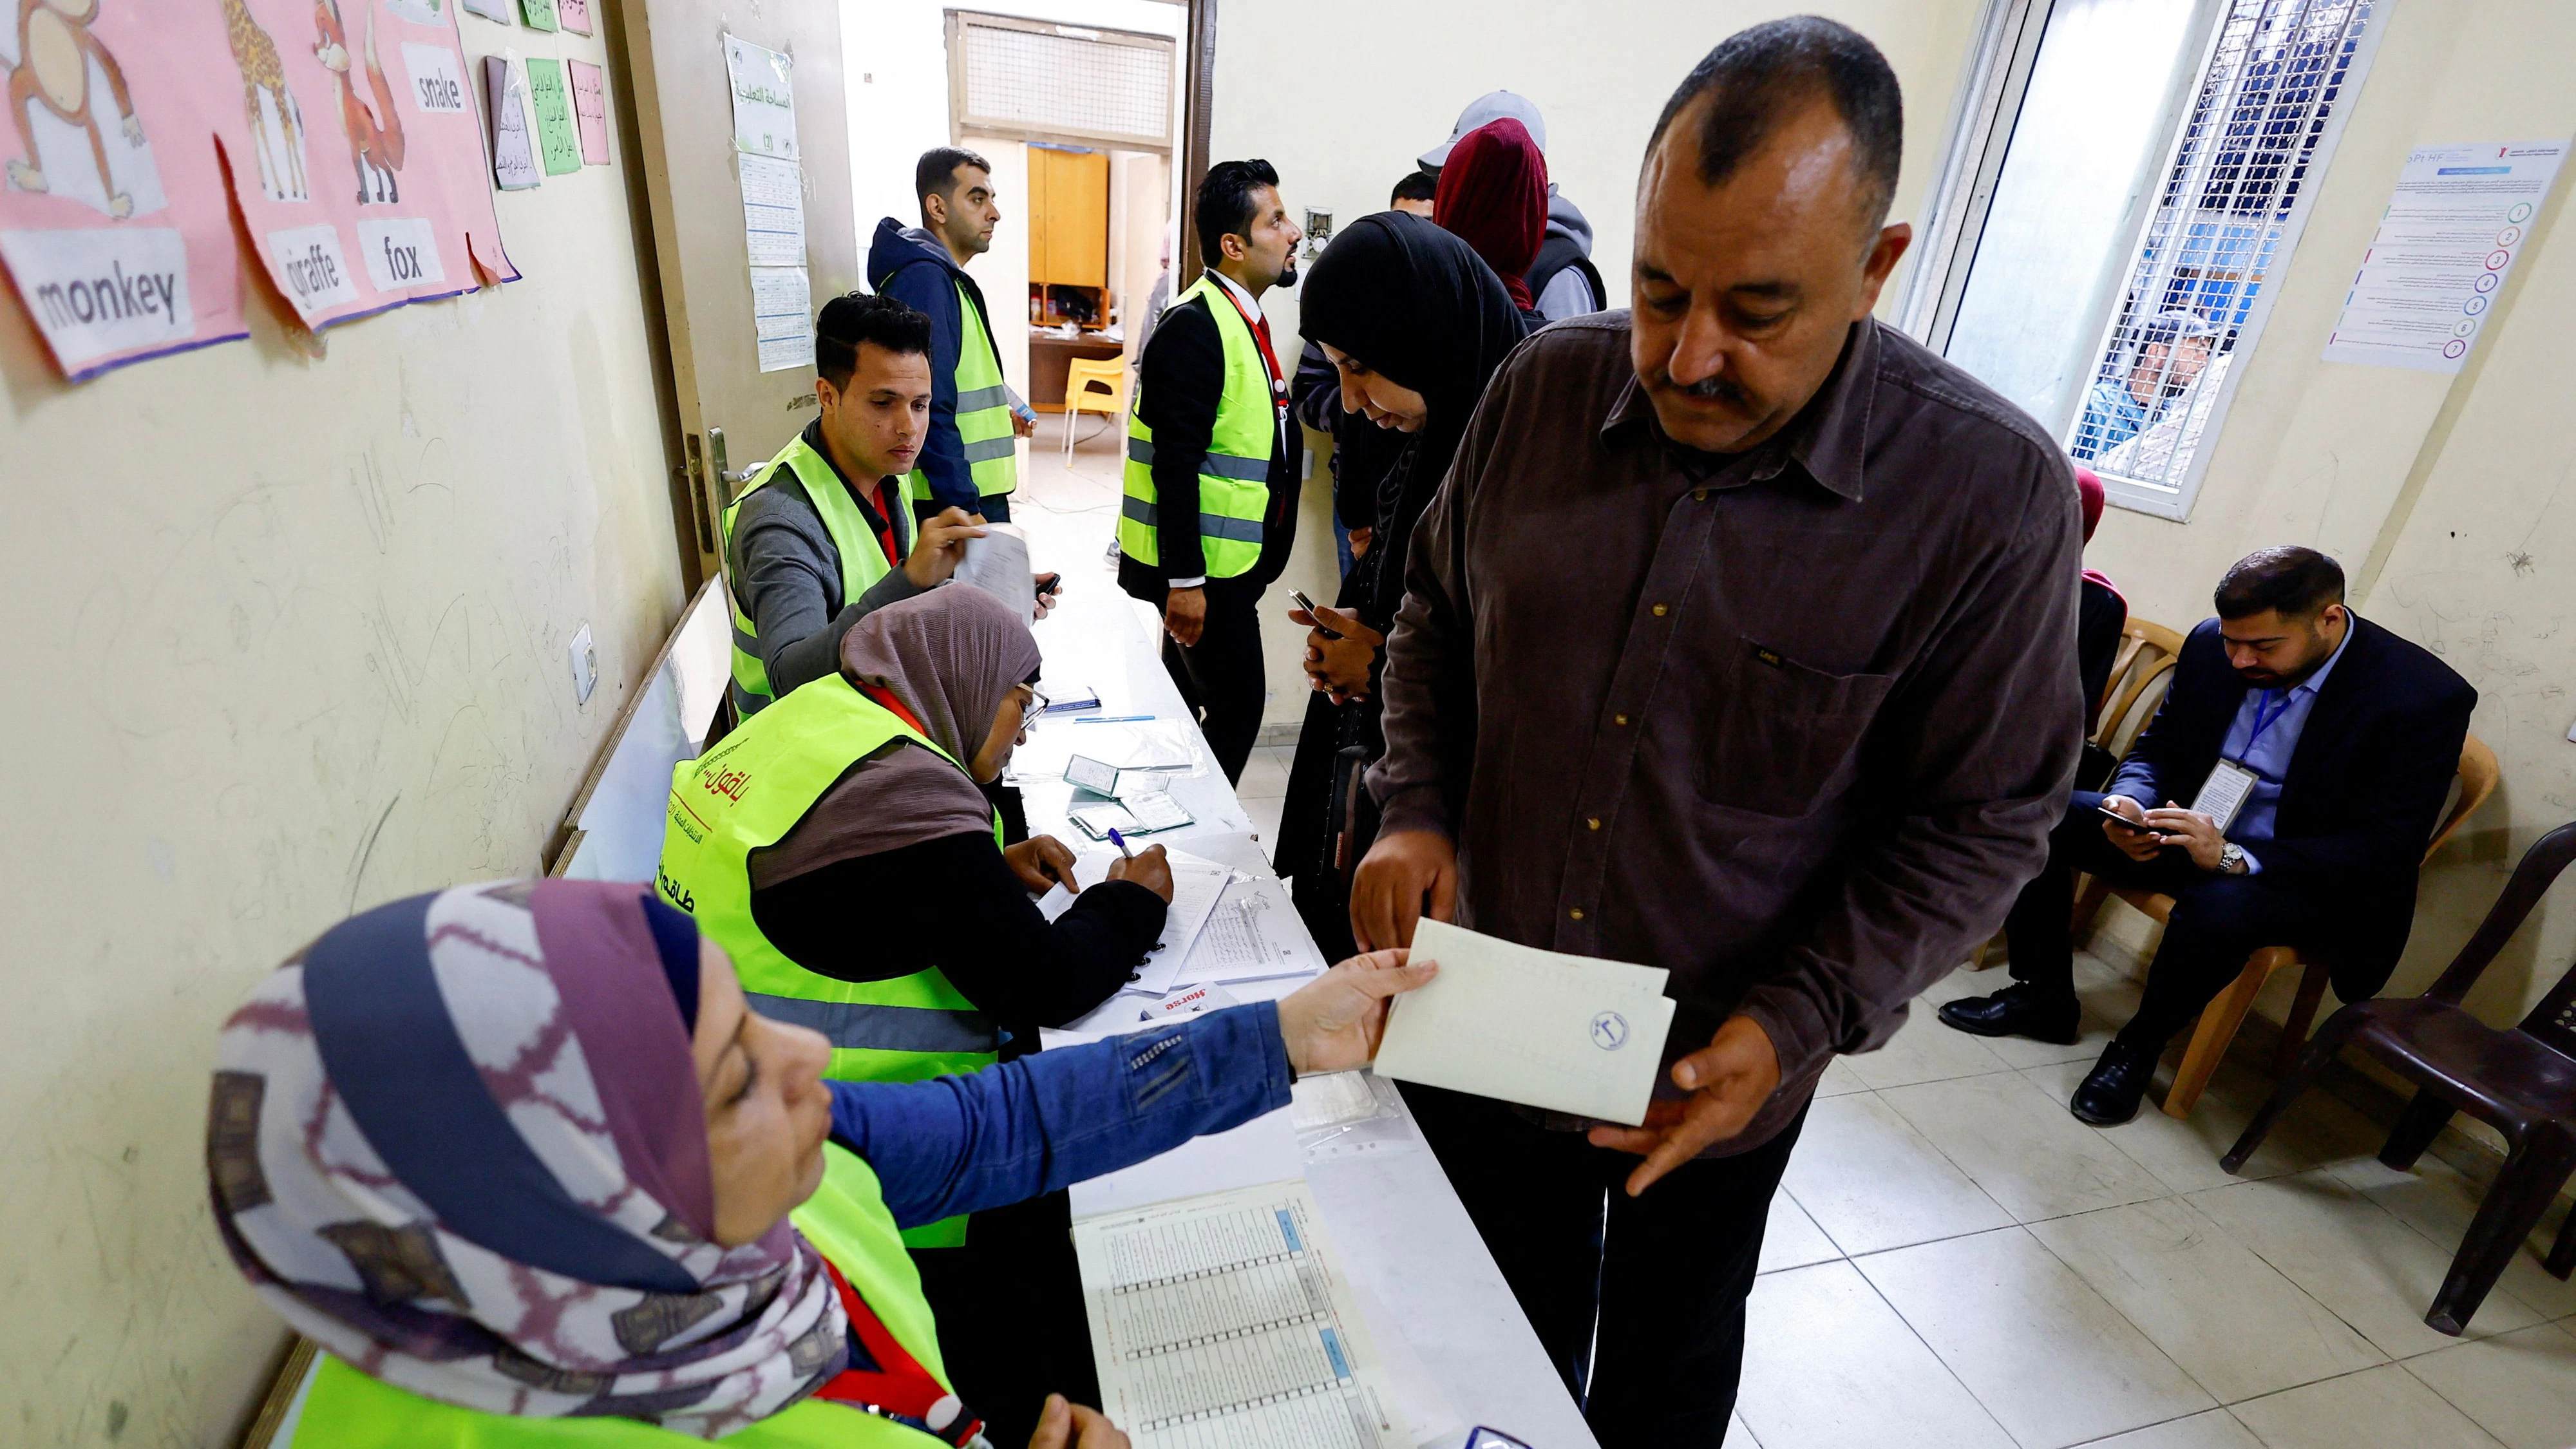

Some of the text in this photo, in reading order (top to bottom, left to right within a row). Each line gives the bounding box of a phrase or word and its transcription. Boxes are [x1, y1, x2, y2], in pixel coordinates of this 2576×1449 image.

[419, 68, 460, 109] snake
[2428, 153, 2445, 162] HF
[2506, 232, 2512, 241] 2
[384, 237, 422, 281] fox
[2494, 256, 2500, 265] 3
[286, 244, 340, 310] giraffe
[36, 260, 175, 329] monkey
[2472, 301, 2479, 310] 5
[661, 875, 695, 913] طاقم
[1165, 989, 1206, 1010] Horse
